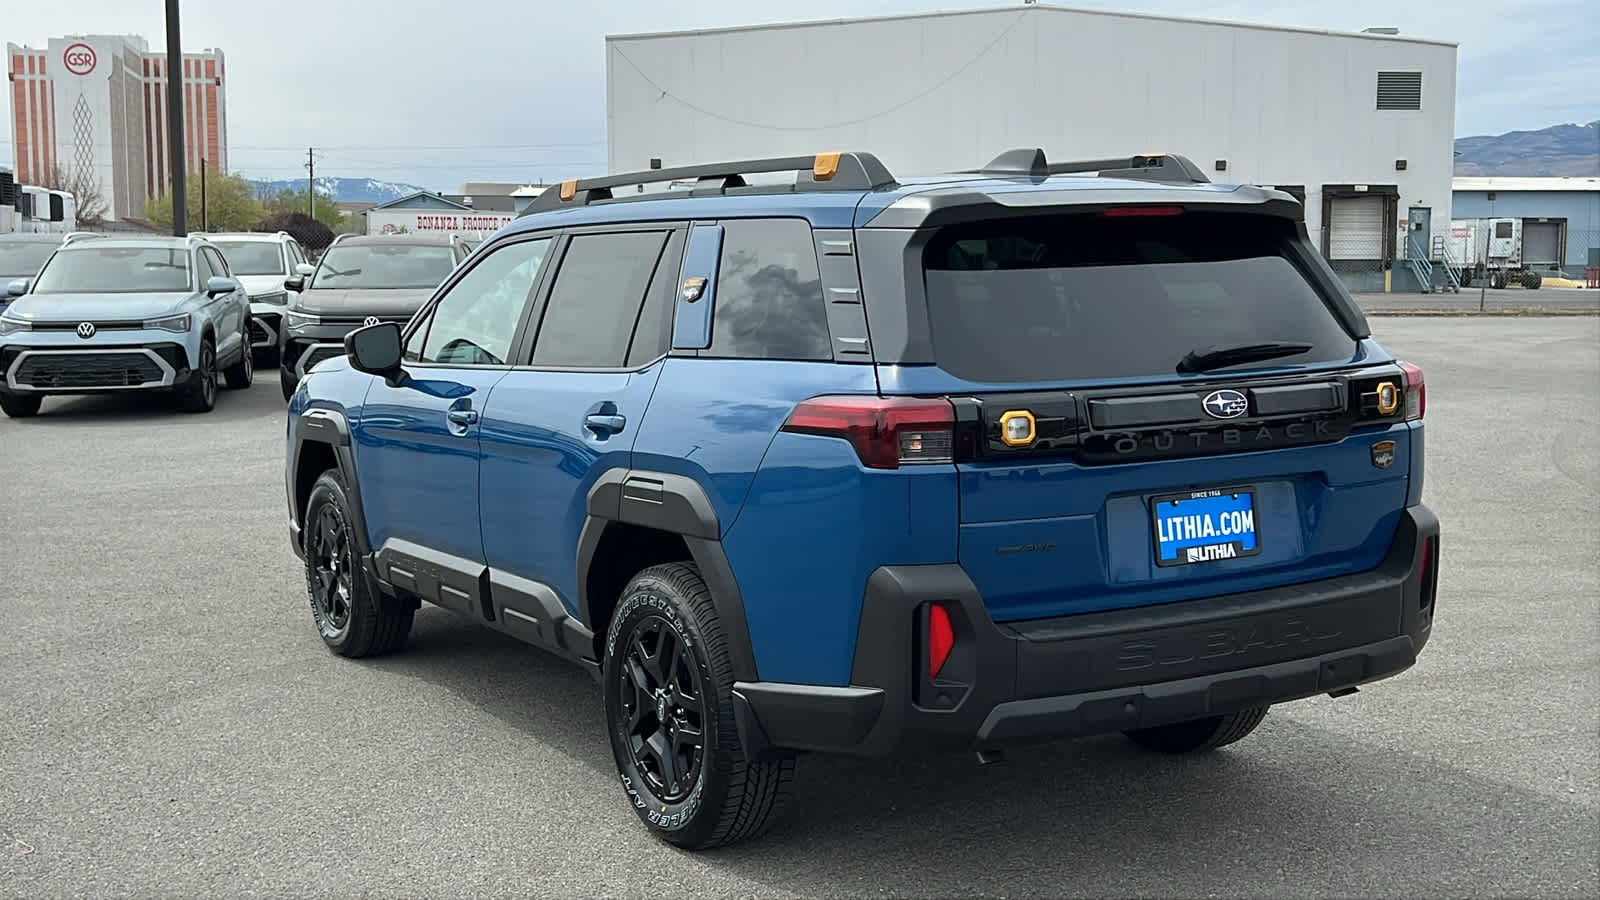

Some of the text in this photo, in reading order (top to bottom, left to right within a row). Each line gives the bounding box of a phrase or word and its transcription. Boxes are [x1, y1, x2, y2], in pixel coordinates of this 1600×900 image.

[67, 52, 92, 66] GSR
[417, 216, 458, 230] BONANZA
[462, 216, 499, 231] PRODUCE
[1114, 420, 1329, 453] OUTBACK
[1157, 509, 1254, 542] LITHIA.COM
[1199, 543, 1236, 560] LITHIA
[620, 773, 648, 809] A/T
